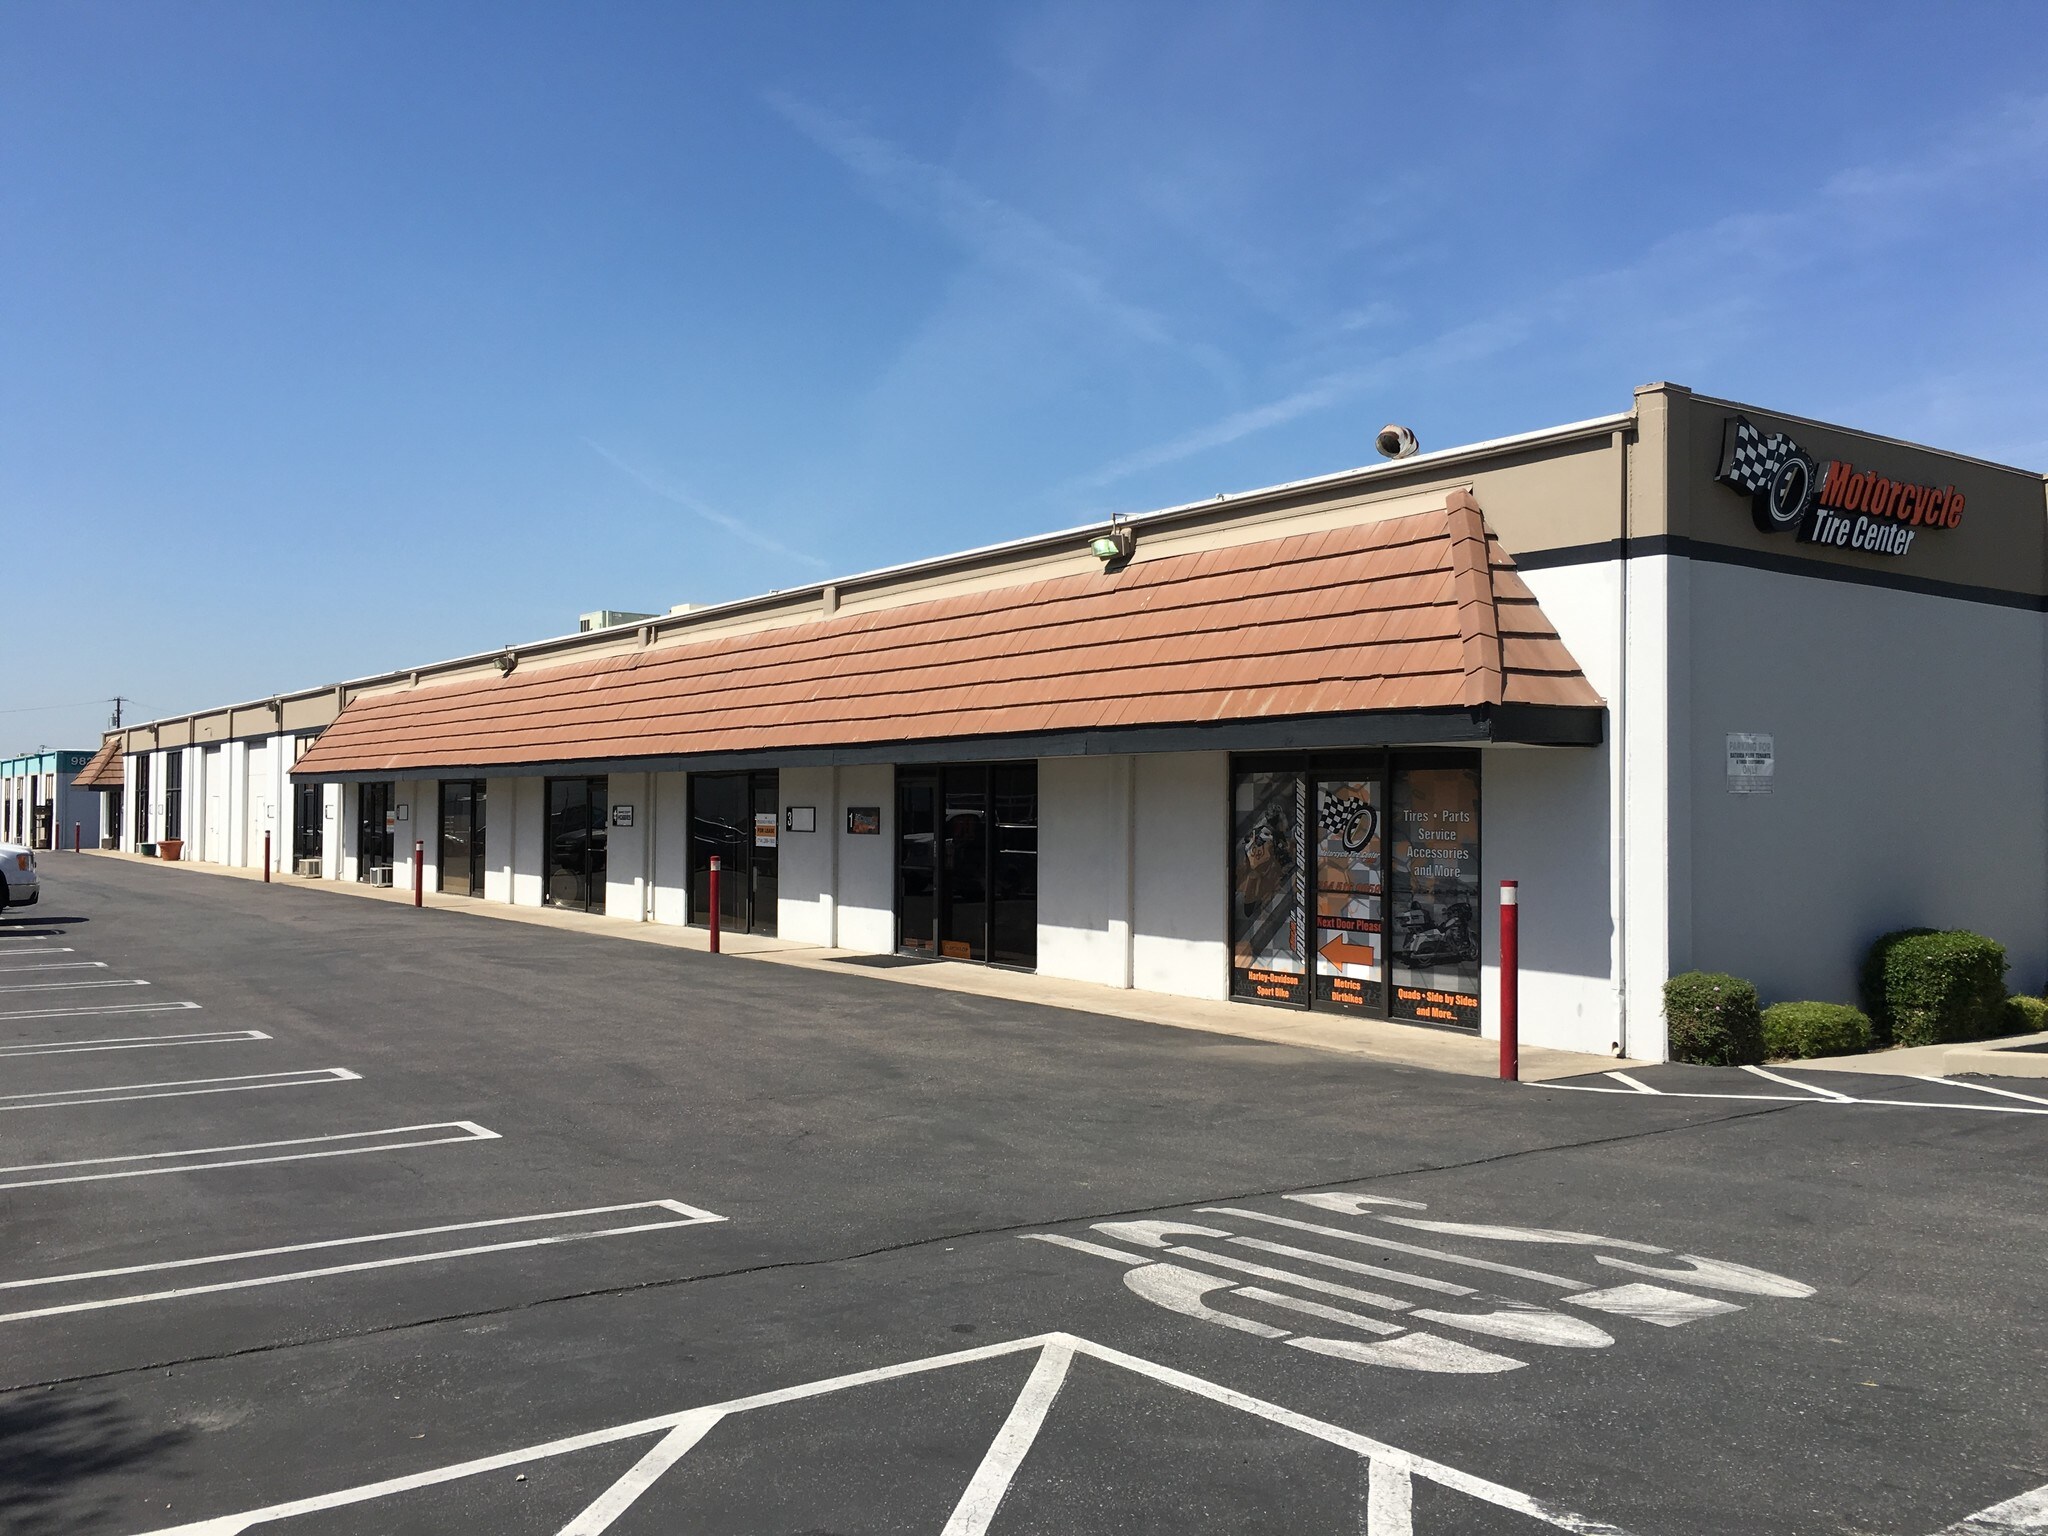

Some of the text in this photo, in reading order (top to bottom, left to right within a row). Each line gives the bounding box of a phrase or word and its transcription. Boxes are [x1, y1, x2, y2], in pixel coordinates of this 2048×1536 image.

[1820, 459, 1966, 529] Motorcycle
[1811, 508, 1916, 555] Tire Center
[787, 811, 792, 826] 3
[848, 812, 853, 828] 1
[1403, 810, 1470, 822] Tires Parts
[1418, 828, 1457, 840] Service
[1320, 850, 1349, 859] Motorcycle
[1361, 851, 1381, 859] Center
[1407, 846, 1469, 860] Accessories
[1294, 777, 1305, 964] Motorcycle Tire Center
[1414, 865, 1461, 878] and More
[1317, 917, 1335, 928] Next
[1336, 918, 1355, 930] Door
[1248, 970, 1299, 985] Harley-Davidson
[1333, 978, 1361, 990] Metrics
[1257, 986, 1290, 998] Sport Bike
[1331, 991, 1364, 1004] Dirtbikes
[1397, 988, 1478, 1007] Quads Side by Sides
[1416, 1007, 1458, 1020] and More...
[1015, 1191, 1818, 1374] STOP
